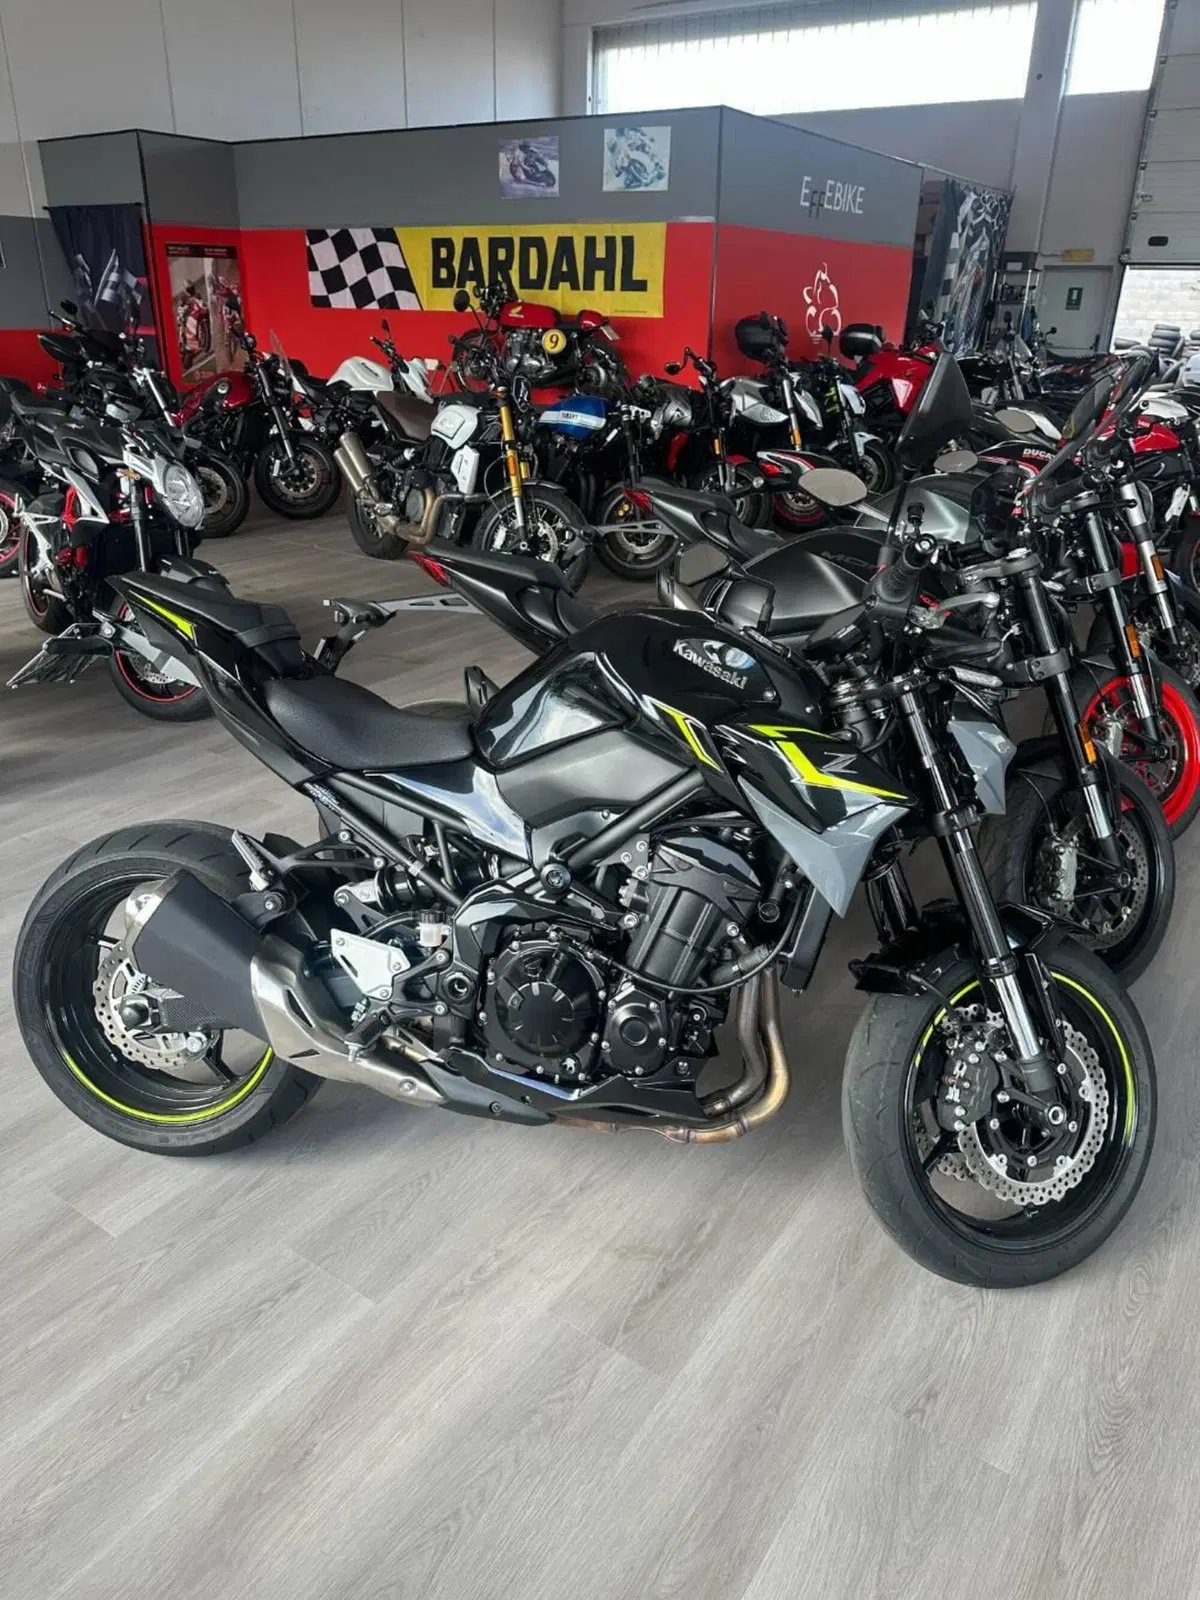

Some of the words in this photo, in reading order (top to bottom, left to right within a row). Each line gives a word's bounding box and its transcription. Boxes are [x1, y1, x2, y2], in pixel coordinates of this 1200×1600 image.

[431, 235, 648, 303] BARDAHL
[549, 333, 559, 349] 9
[673, 639, 748, 690] Kawasaki
